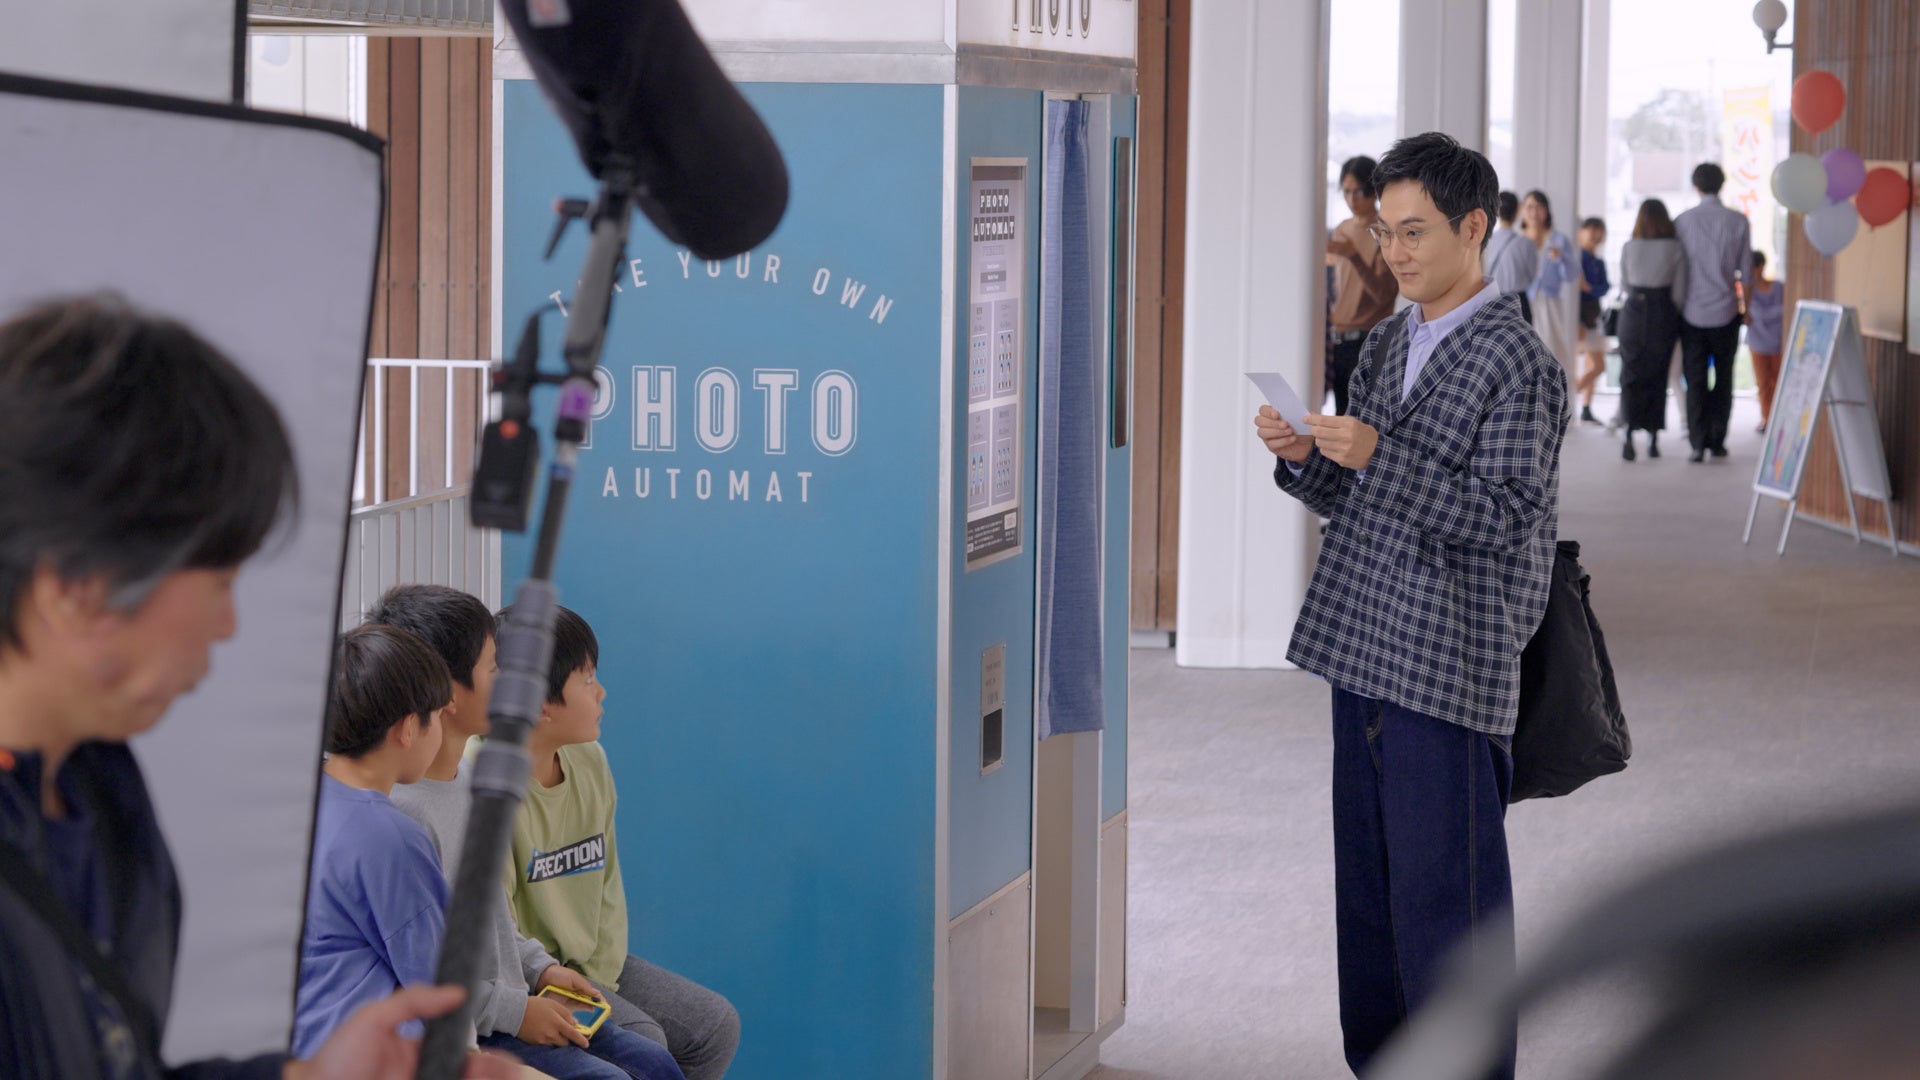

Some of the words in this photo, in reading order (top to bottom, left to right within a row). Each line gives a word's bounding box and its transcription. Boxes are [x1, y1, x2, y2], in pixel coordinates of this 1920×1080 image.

[980, 193, 1009, 208] PHOTO
[974, 221, 1015, 236] AUTOMAT
[550, 258, 648, 318] TE
[812, 267, 894, 325] OWN
[602, 466, 813, 503] AUTOMAT
